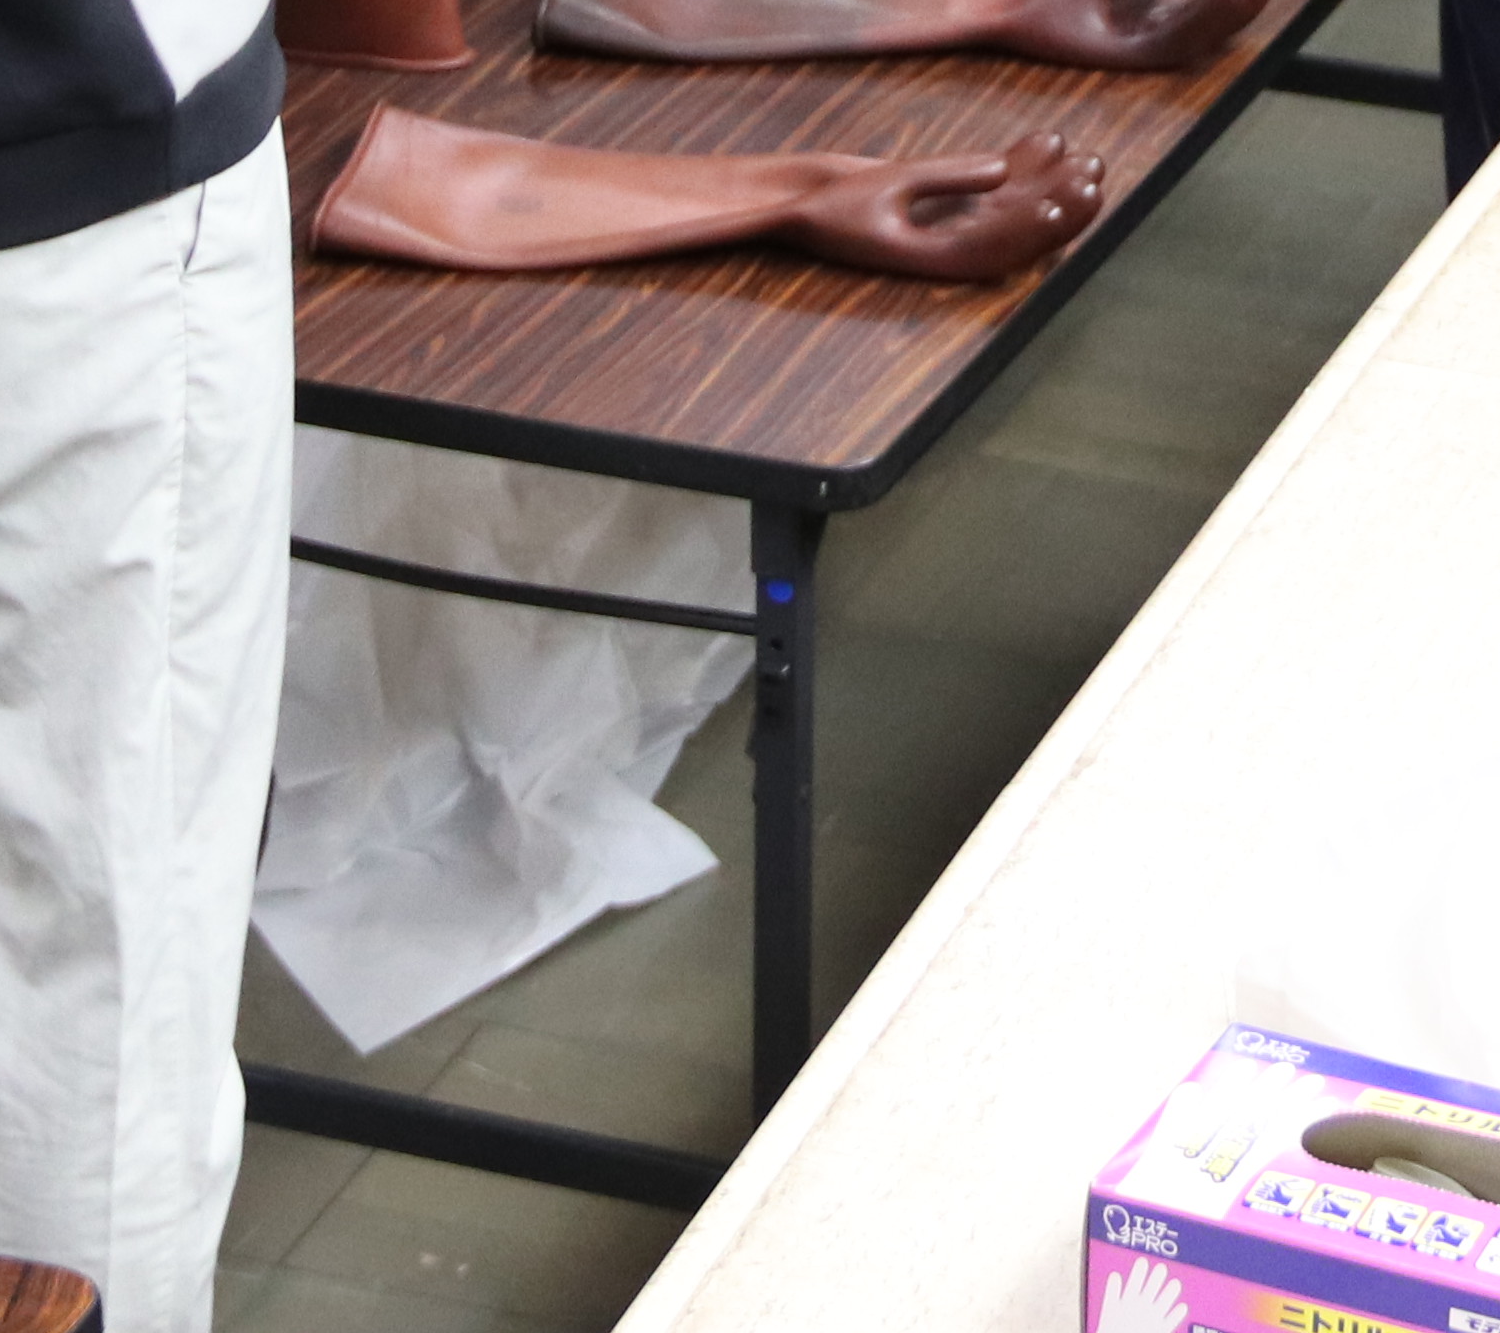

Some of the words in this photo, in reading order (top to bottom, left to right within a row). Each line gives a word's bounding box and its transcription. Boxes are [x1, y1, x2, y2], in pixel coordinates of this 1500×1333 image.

[1131, 1215, 1179, 1238] エステー
[1130, 1235, 1178, 1256] PRO
